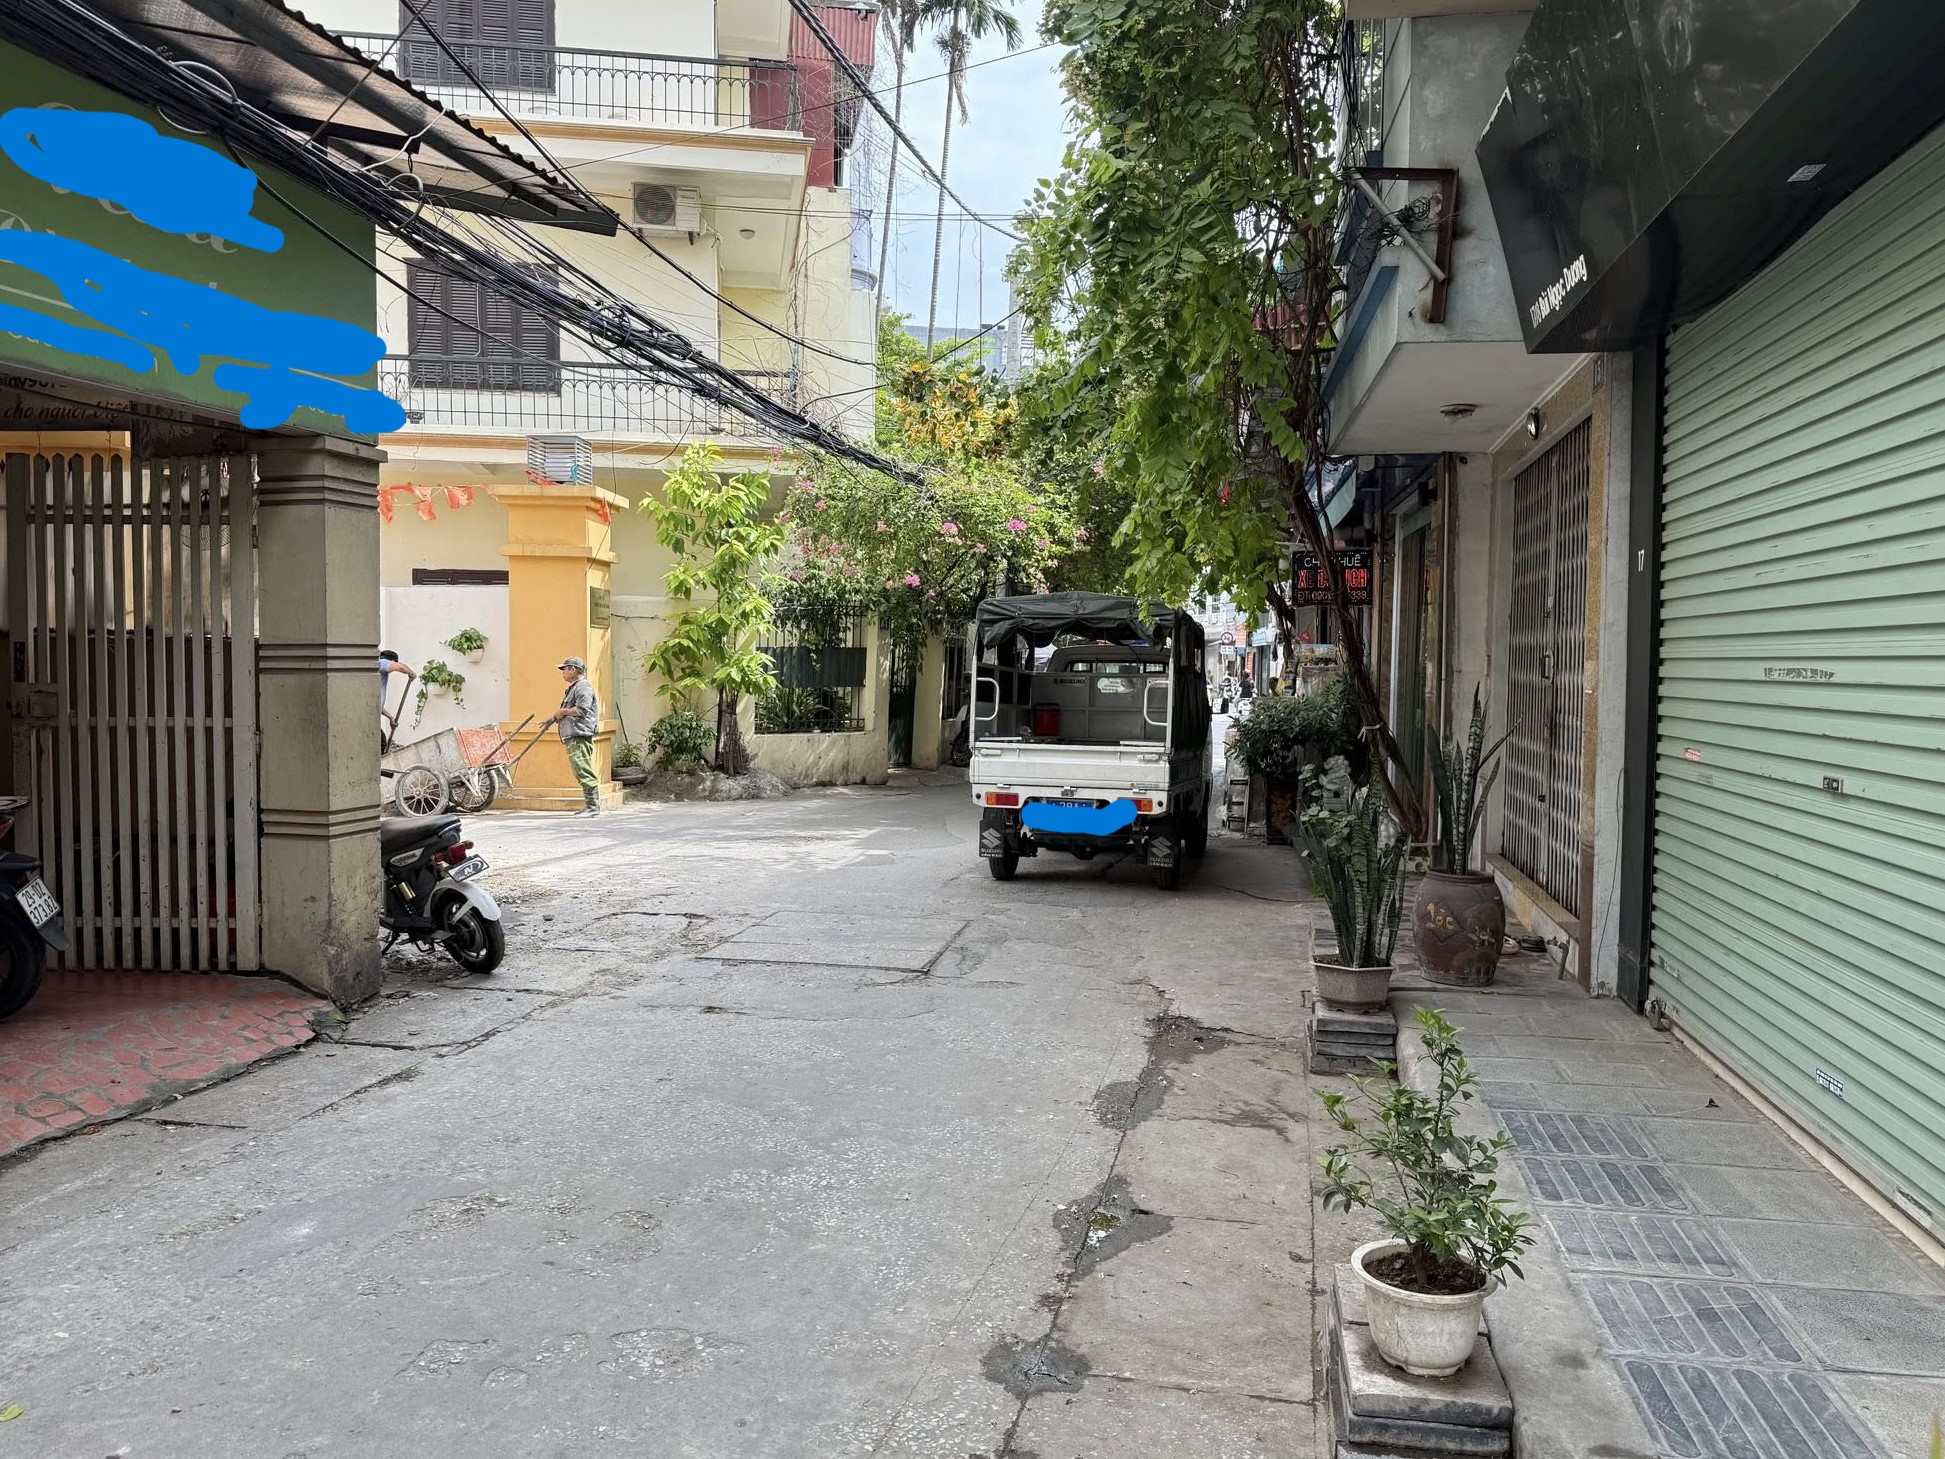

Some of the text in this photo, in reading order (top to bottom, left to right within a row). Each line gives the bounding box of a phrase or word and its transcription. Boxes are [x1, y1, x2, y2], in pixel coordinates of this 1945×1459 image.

[1547, 278, 1566, 311] Ngọc
[3, 393, 33, 419] cho
[1638, 549, 1645, 572] 17
[30, 896, 58, 925] 373.82
